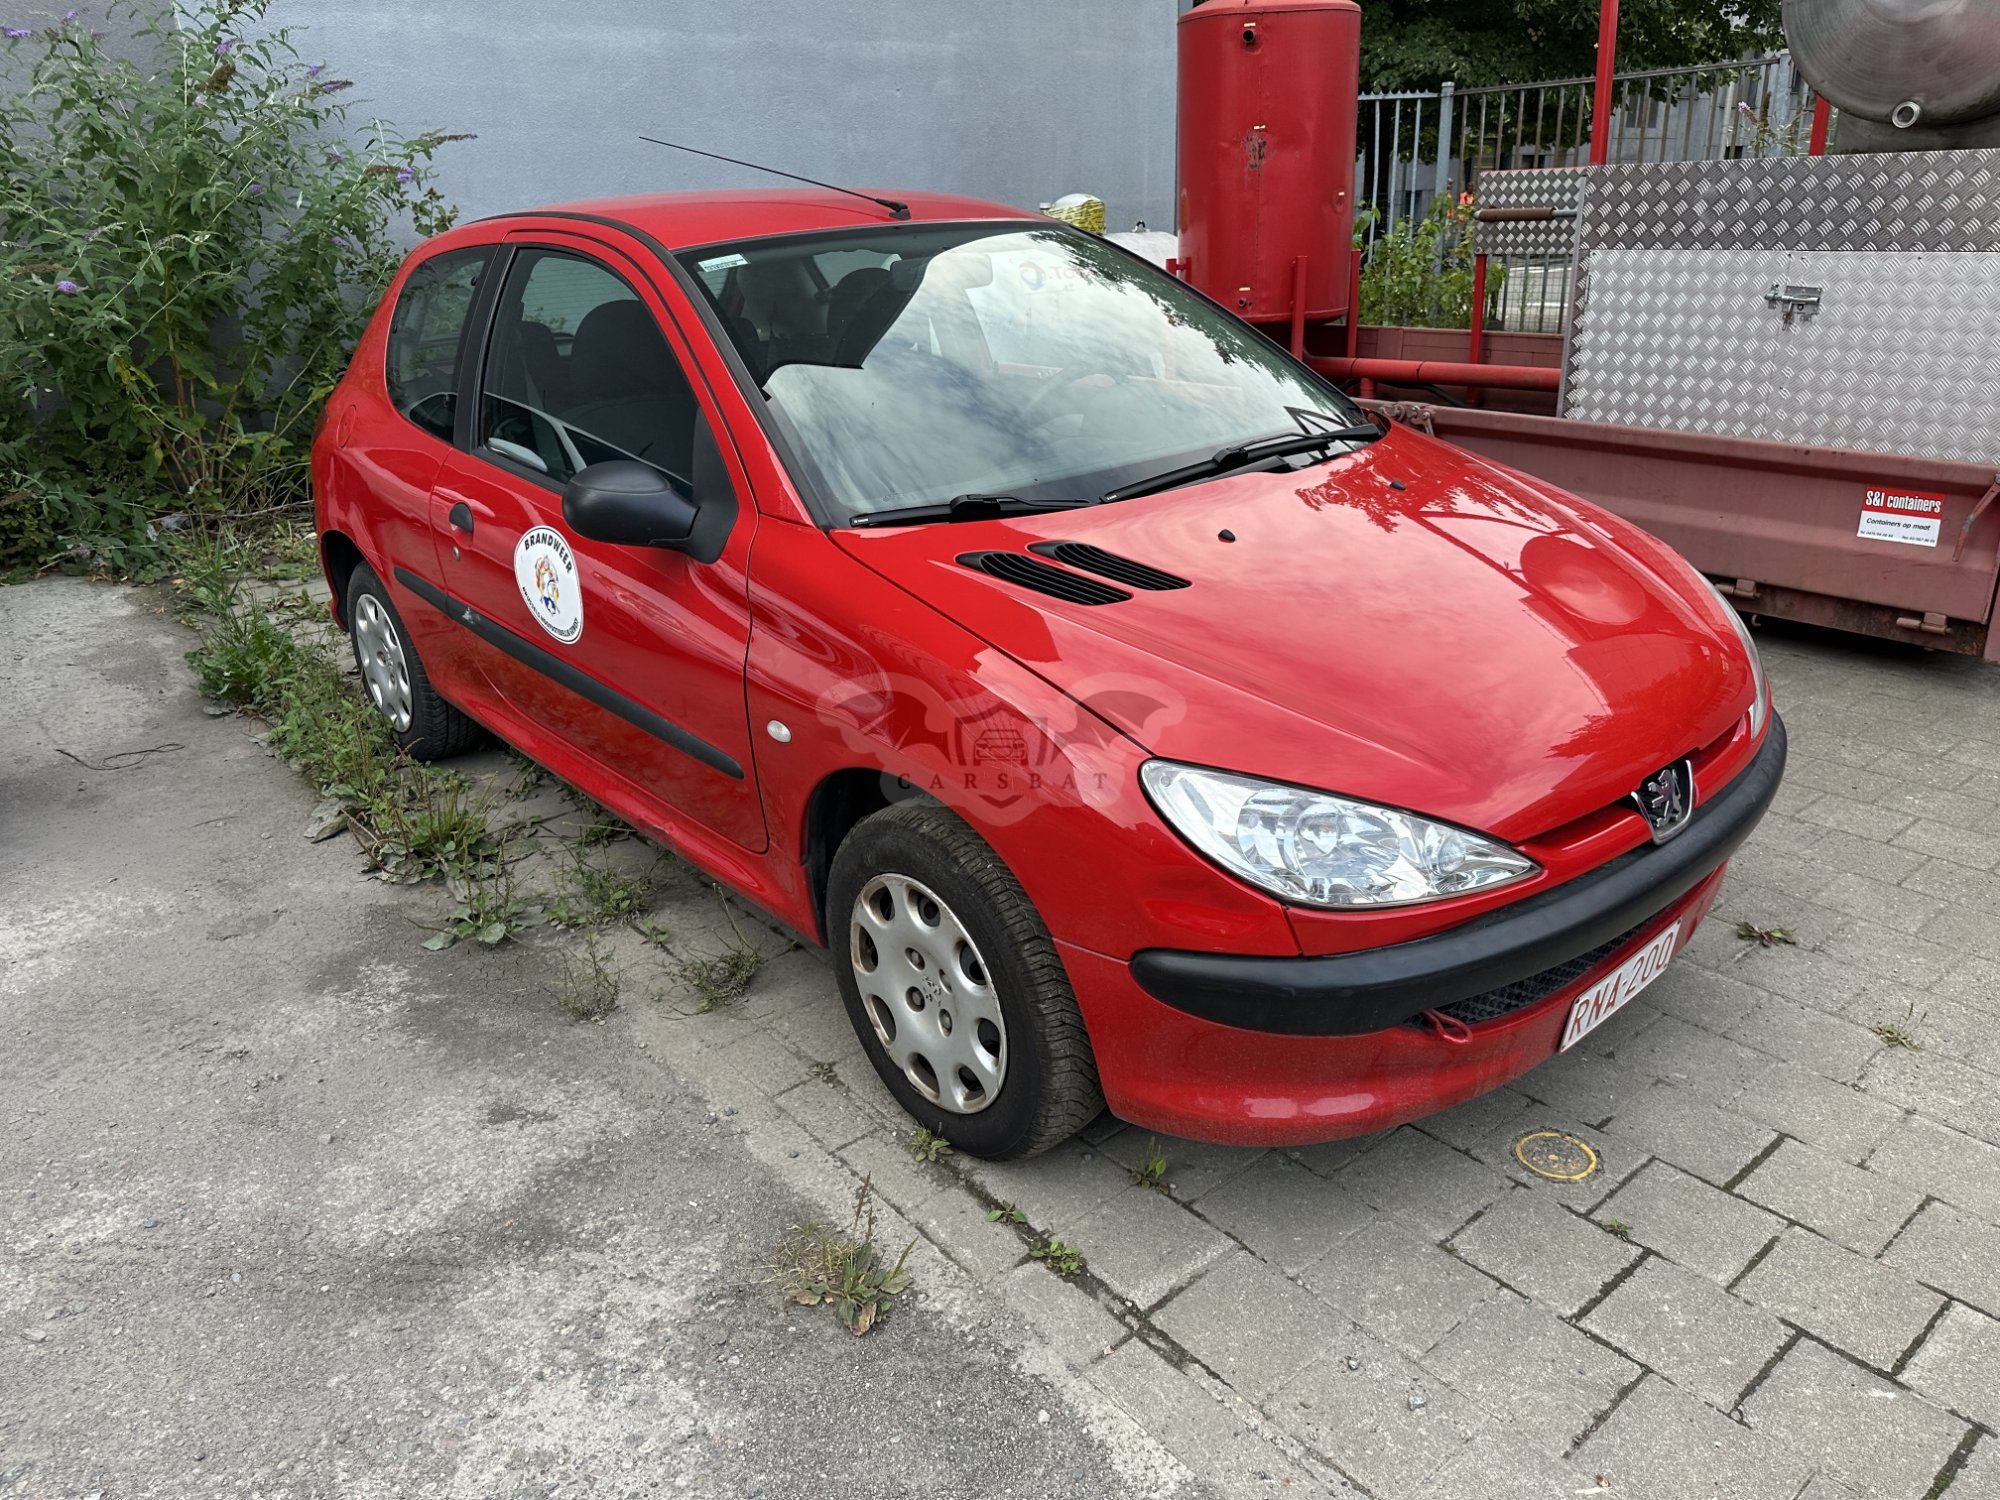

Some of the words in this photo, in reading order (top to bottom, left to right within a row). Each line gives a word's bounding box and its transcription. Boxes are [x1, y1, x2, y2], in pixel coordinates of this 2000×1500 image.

[1865, 490, 1885, 506] S&I
[1887, 495, 1941, 513] containers
[1866, 518, 1901, 527] Containers
[524, 532, 572, 573] BRANDWEER
[1568, 932, 1674, 1041] RNA-200
